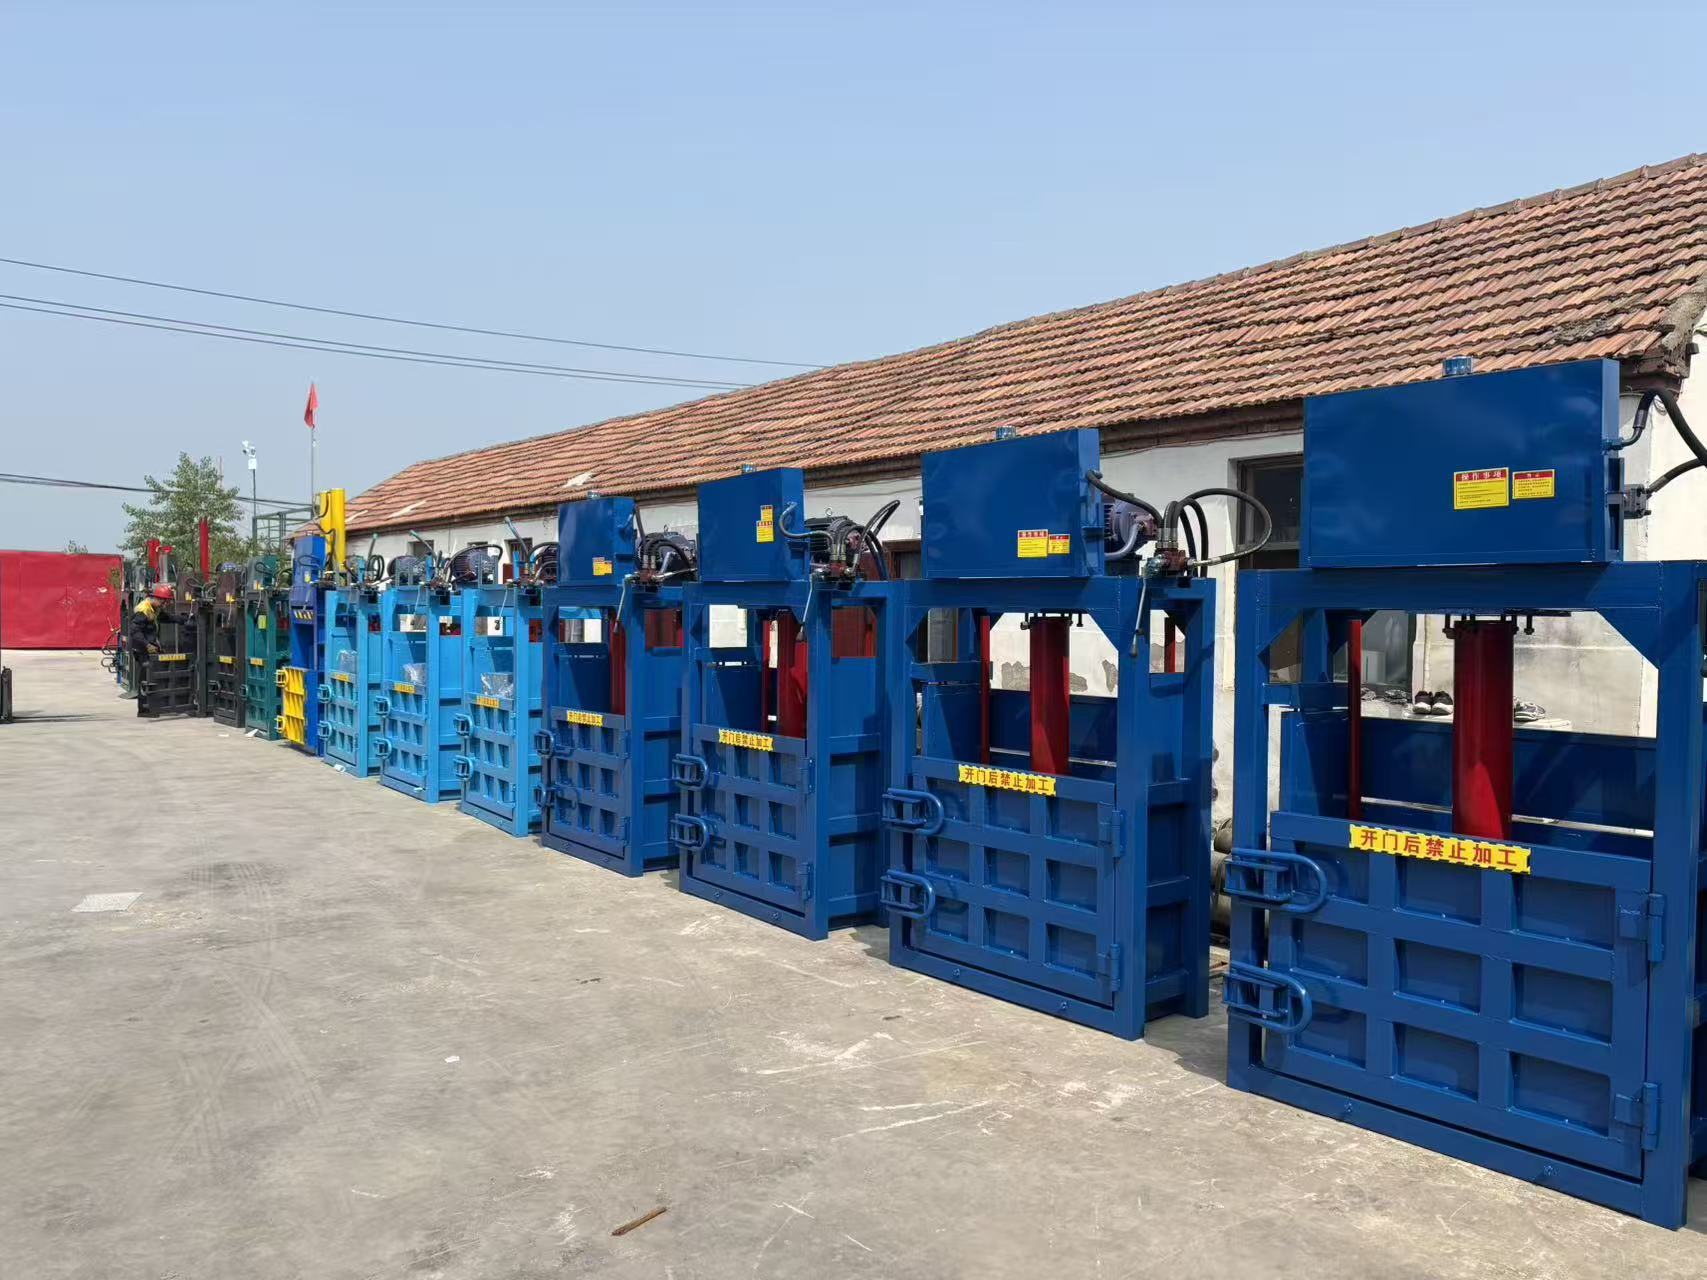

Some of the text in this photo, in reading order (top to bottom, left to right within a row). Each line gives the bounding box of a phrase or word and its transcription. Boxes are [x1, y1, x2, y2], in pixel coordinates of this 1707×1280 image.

[964, 767, 1050, 792] 开门后禁止加工
[1360, 829, 1518, 867] 开门后禁止加工
